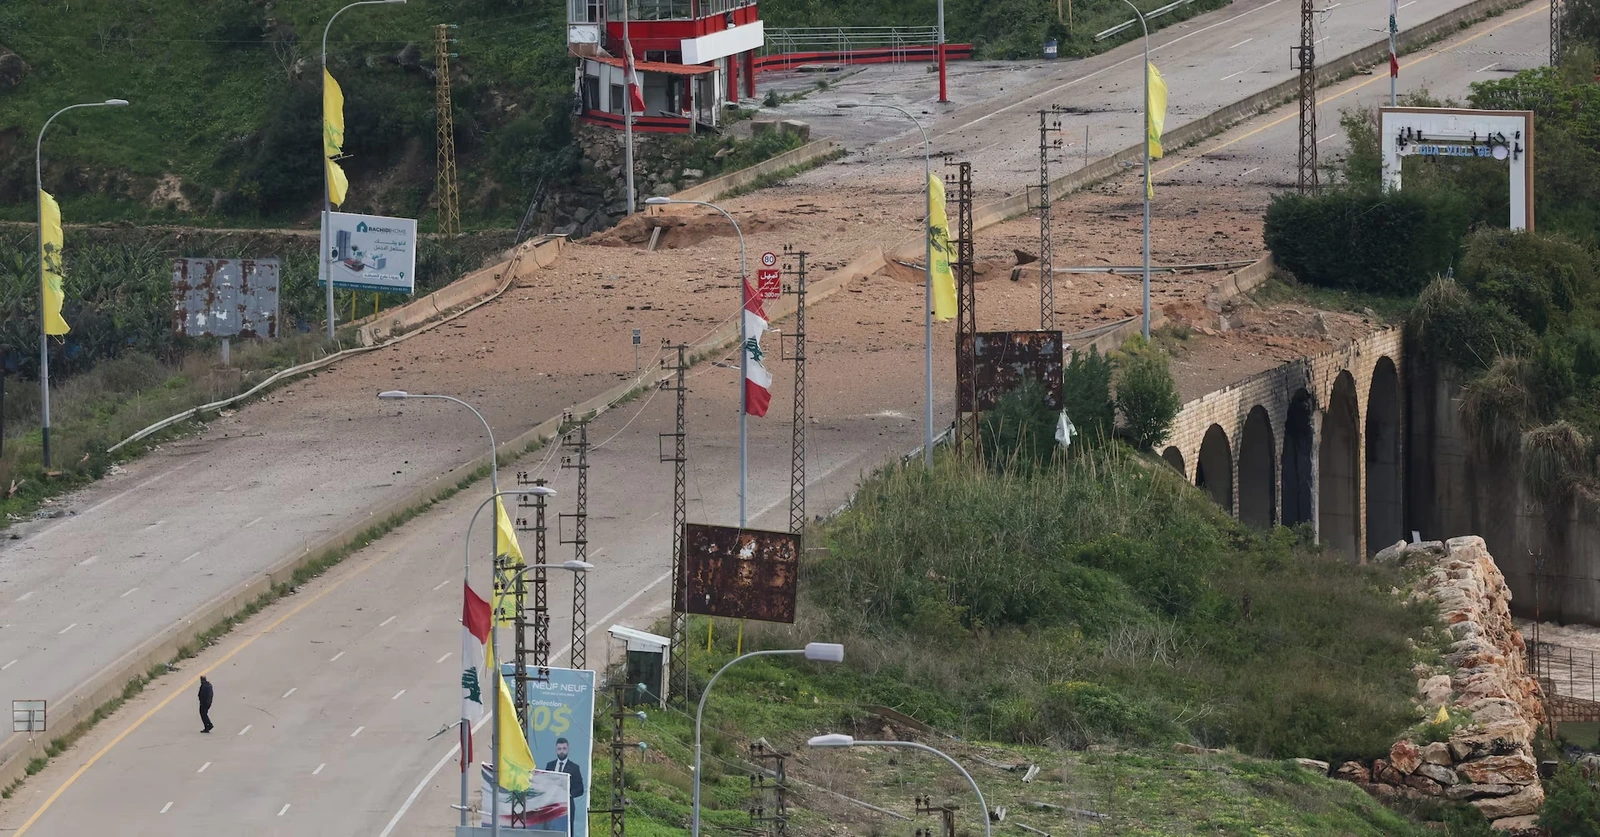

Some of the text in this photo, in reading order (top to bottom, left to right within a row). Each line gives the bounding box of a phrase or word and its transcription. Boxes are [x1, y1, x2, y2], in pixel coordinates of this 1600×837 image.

[1447, 145, 1491, 157] VILLGE
[533, 682, 588, 692] NEUF NEUF
[532, 699, 562, 708] Collection
